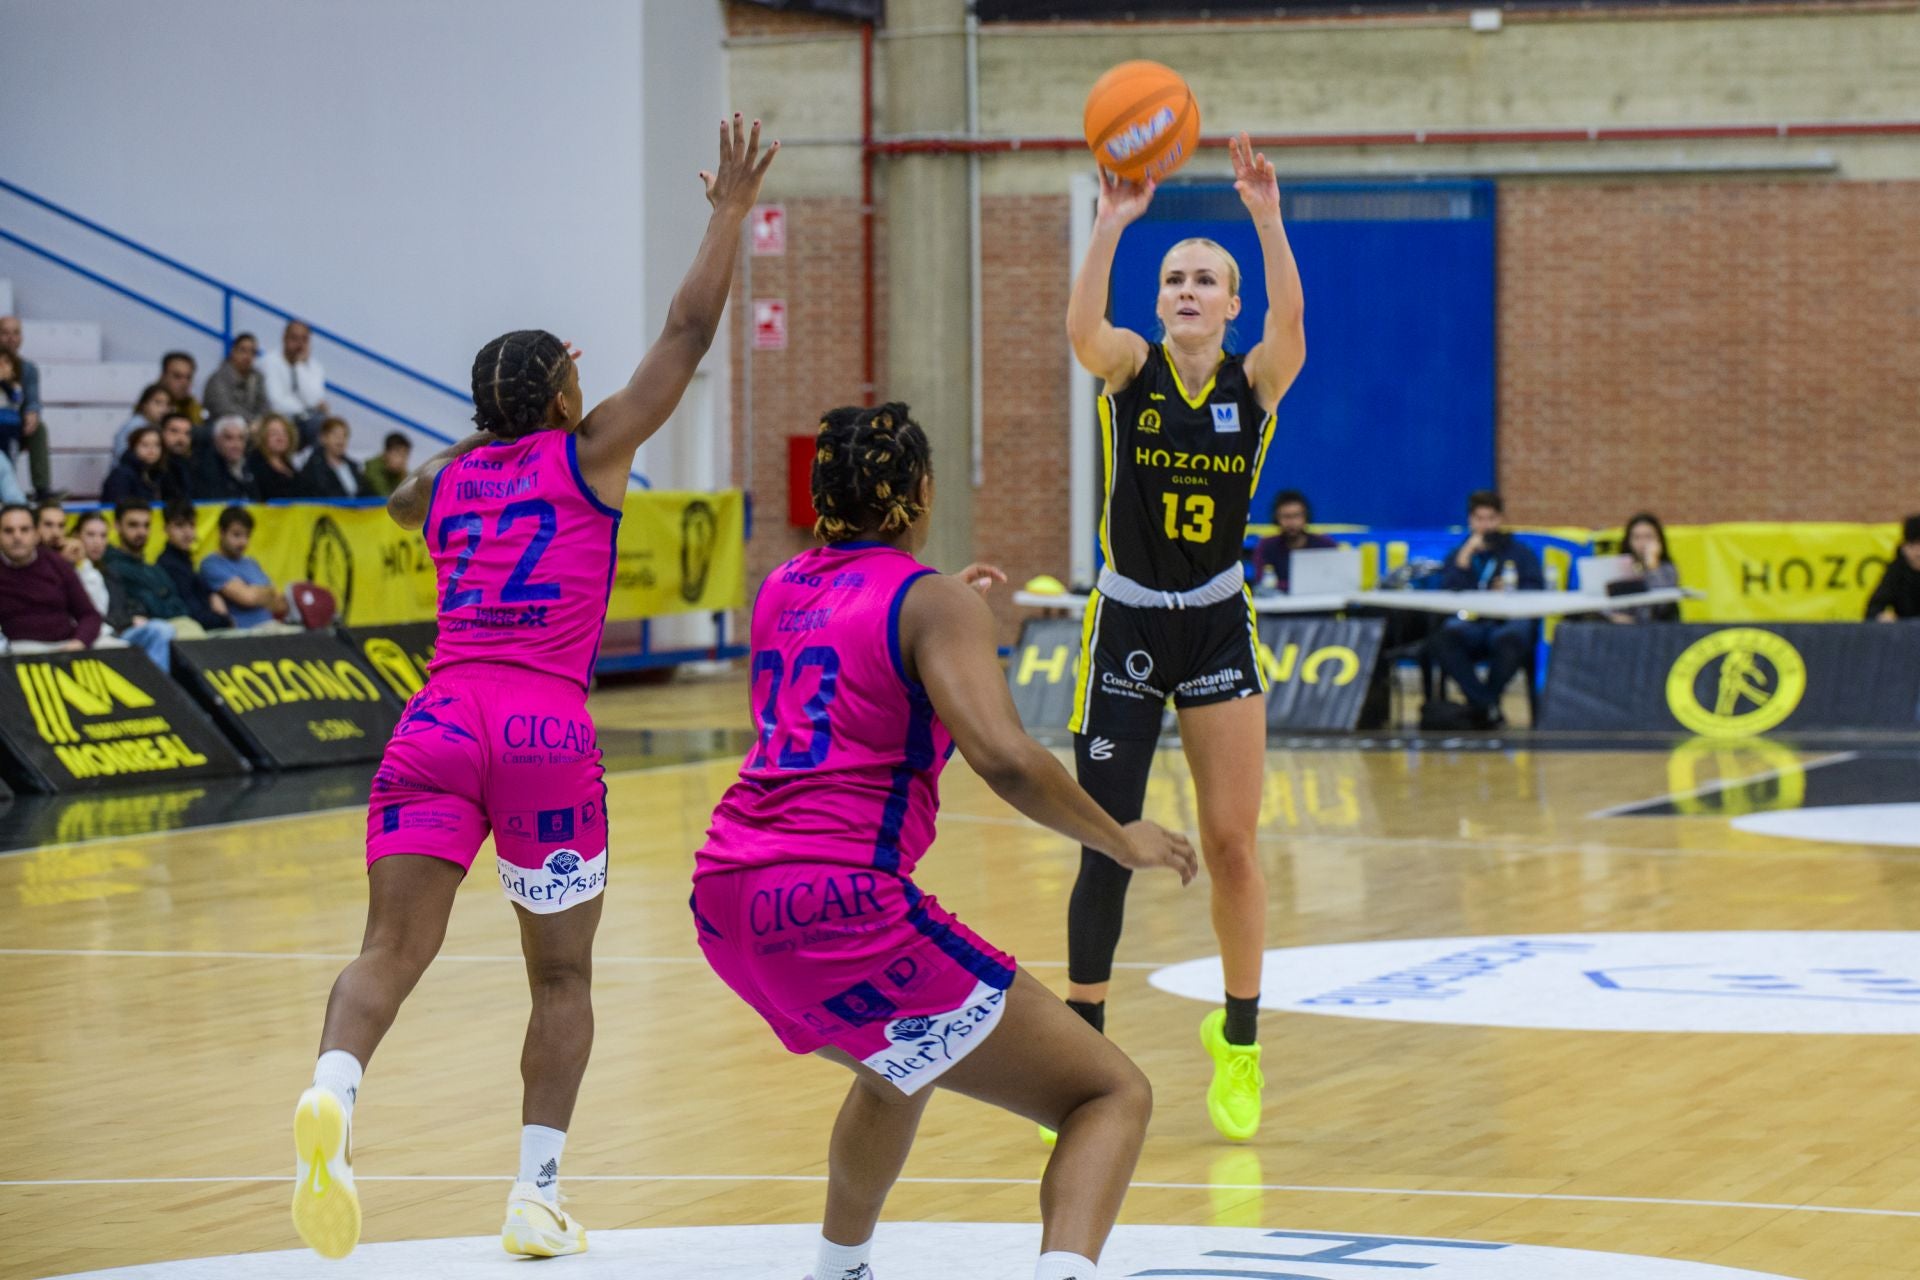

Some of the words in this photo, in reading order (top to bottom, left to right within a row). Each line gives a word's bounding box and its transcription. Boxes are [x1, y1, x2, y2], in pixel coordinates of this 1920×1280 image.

[1136, 447, 1245, 473] HOZONO
[1171, 475, 1209, 486] GLOBAL
[456, 471, 539, 501] TOUSSAINT
[1162, 492, 1215, 544] 13
[437, 498, 561, 614] 22
[203, 658, 381, 714] HOZONO
[751, 646, 840, 770] 23
[55, 733, 208, 779] MONREAL
[503, 714, 590, 755] CICAR
[750, 872, 885, 936] CICAR
